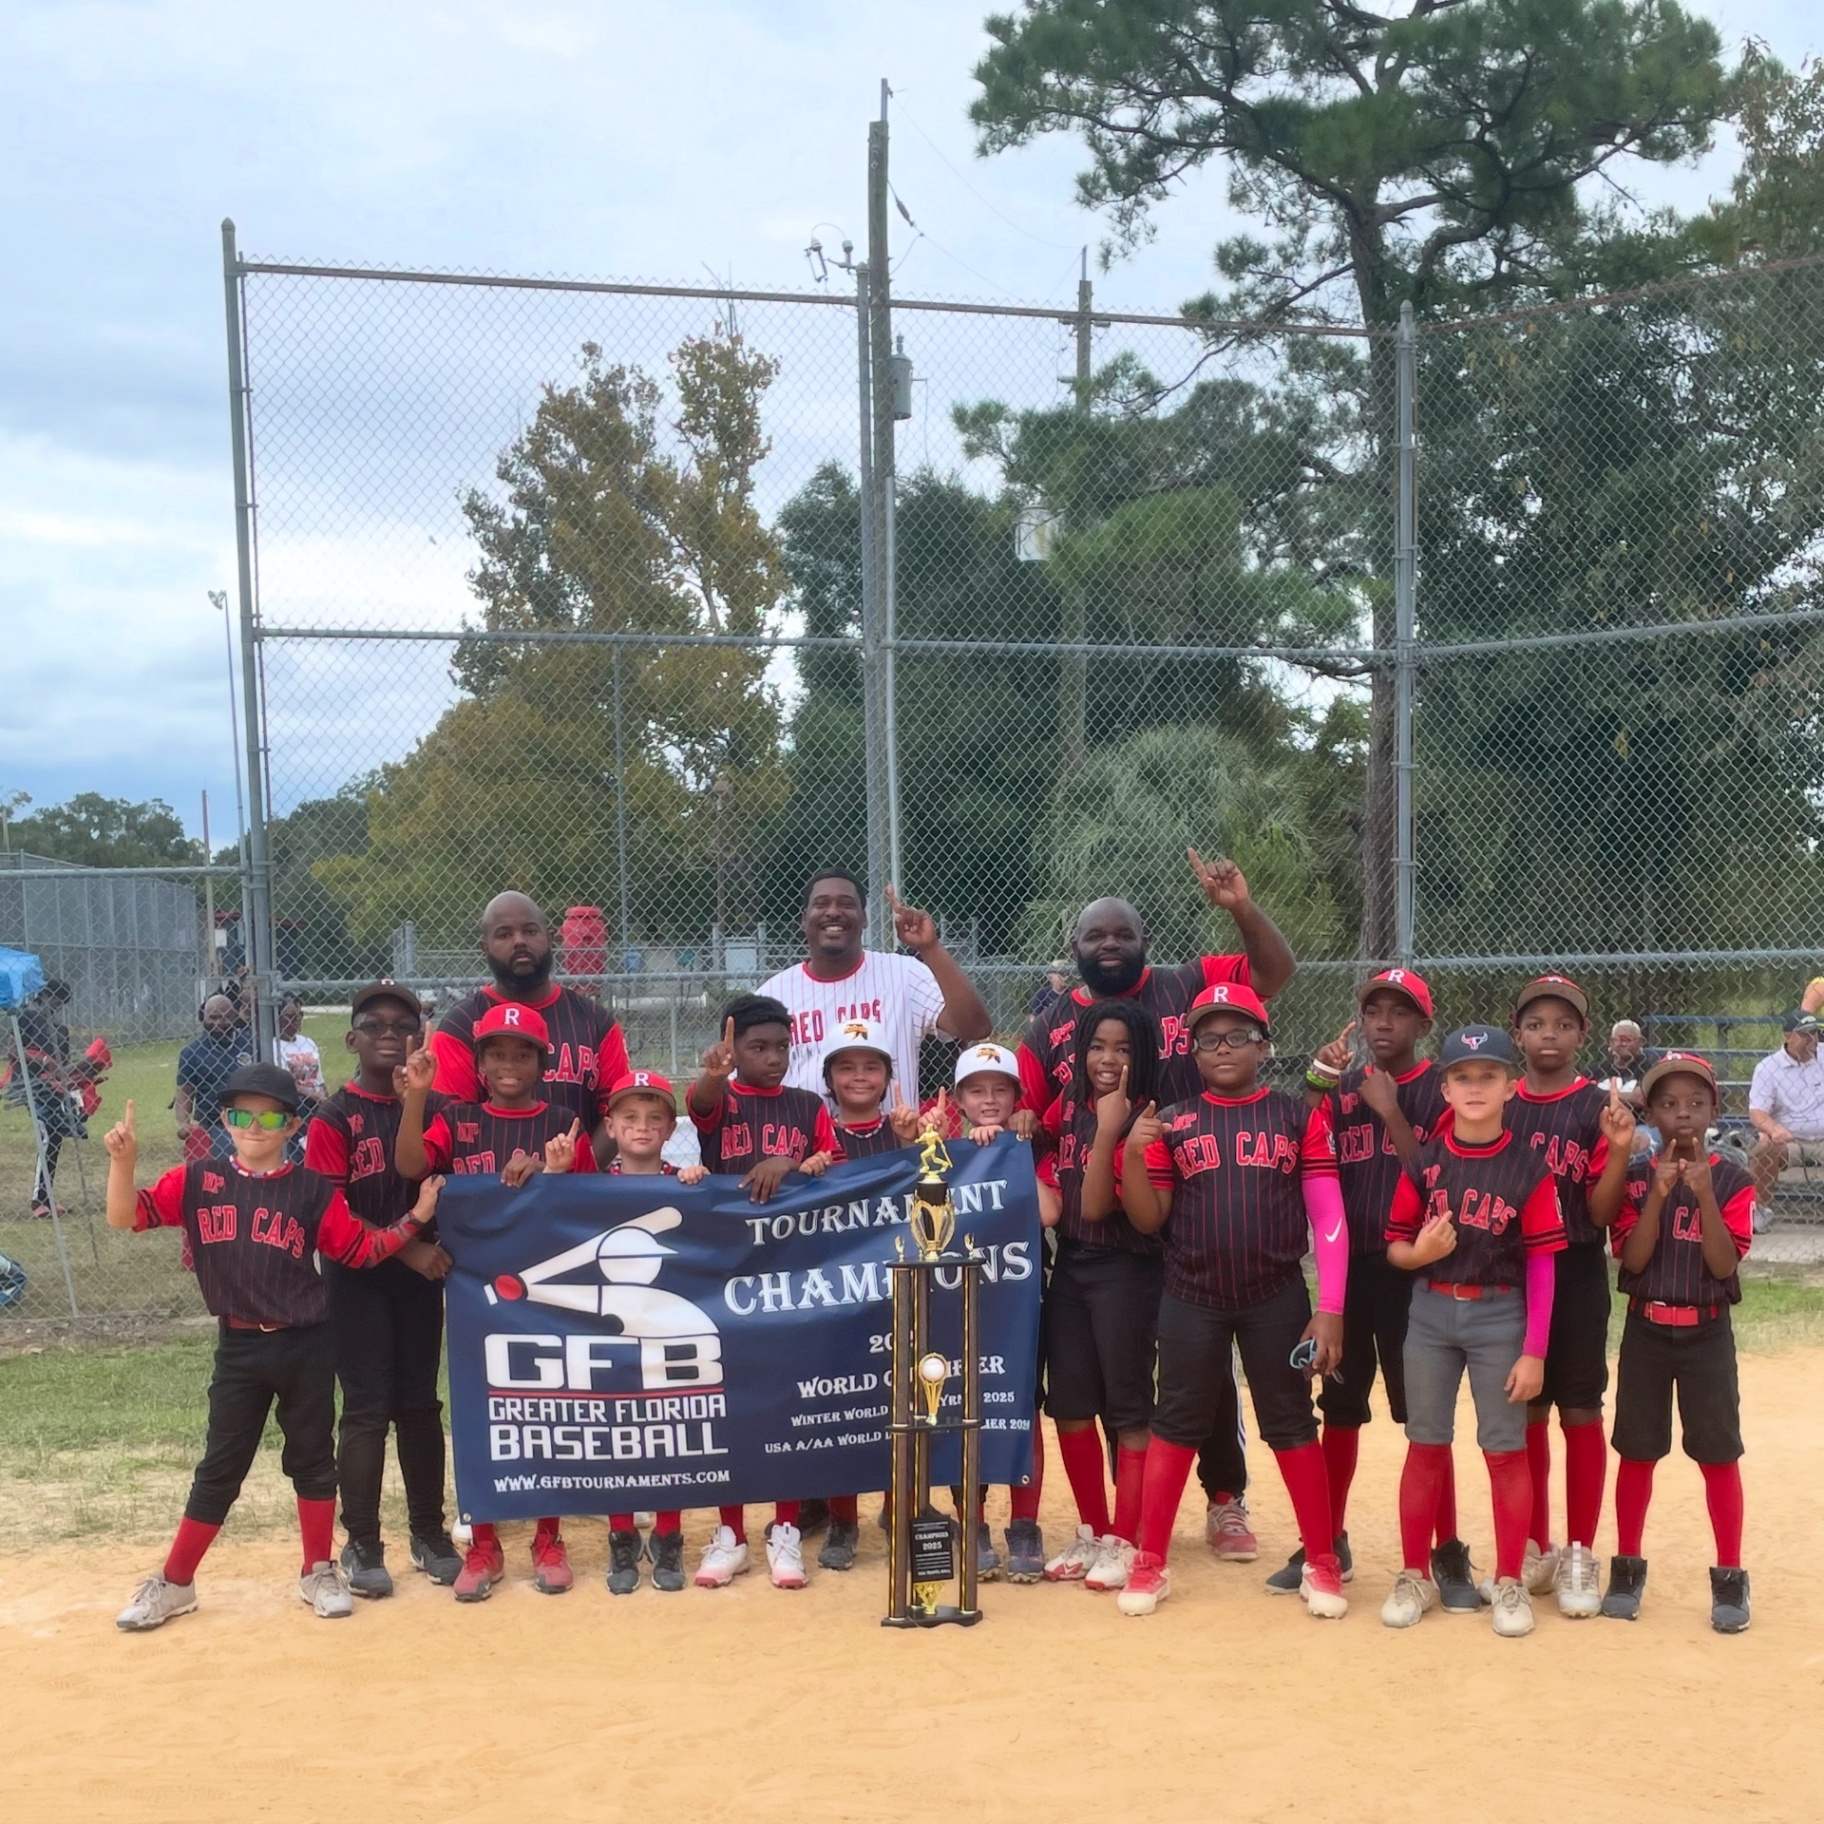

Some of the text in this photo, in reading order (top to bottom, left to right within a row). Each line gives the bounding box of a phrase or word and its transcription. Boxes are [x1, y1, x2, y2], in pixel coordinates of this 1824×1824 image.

[1213, 986, 1229, 1003] R
[504, 1007, 520, 1026] R
[789, 1009, 824, 1047] RED
[634, 1072, 650, 1087] R
[721, 1122, 808, 1162] RED CAPS
[1173, 1131, 1300, 1180] RED CAPS
[1459, 1188, 1517, 1235] CAPS
[197, 1205, 305, 1258] RED CAPS
[484, 1333, 724, 1390] GFB
[797, 1372, 878, 1399] WORLD
[488, 1394, 726, 1423] GREATER FLORIDA
[791, 1411, 840, 1428] WINTER
[844, 1404, 889, 1421] WORLD
[983, 1391, 1015, 1403] 2025
[489, 1421, 729, 1461] BASEBALL
[764, 1441, 792, 1454] USA
[795, 1436, 834, 1452] A/AA
[837, 1430, 882, 1446] WORLD
[493, 1470, 731, 1493] WWW.GFBTOURNAMENTS.COM
[922, 1541, 943, 1551] 2025
